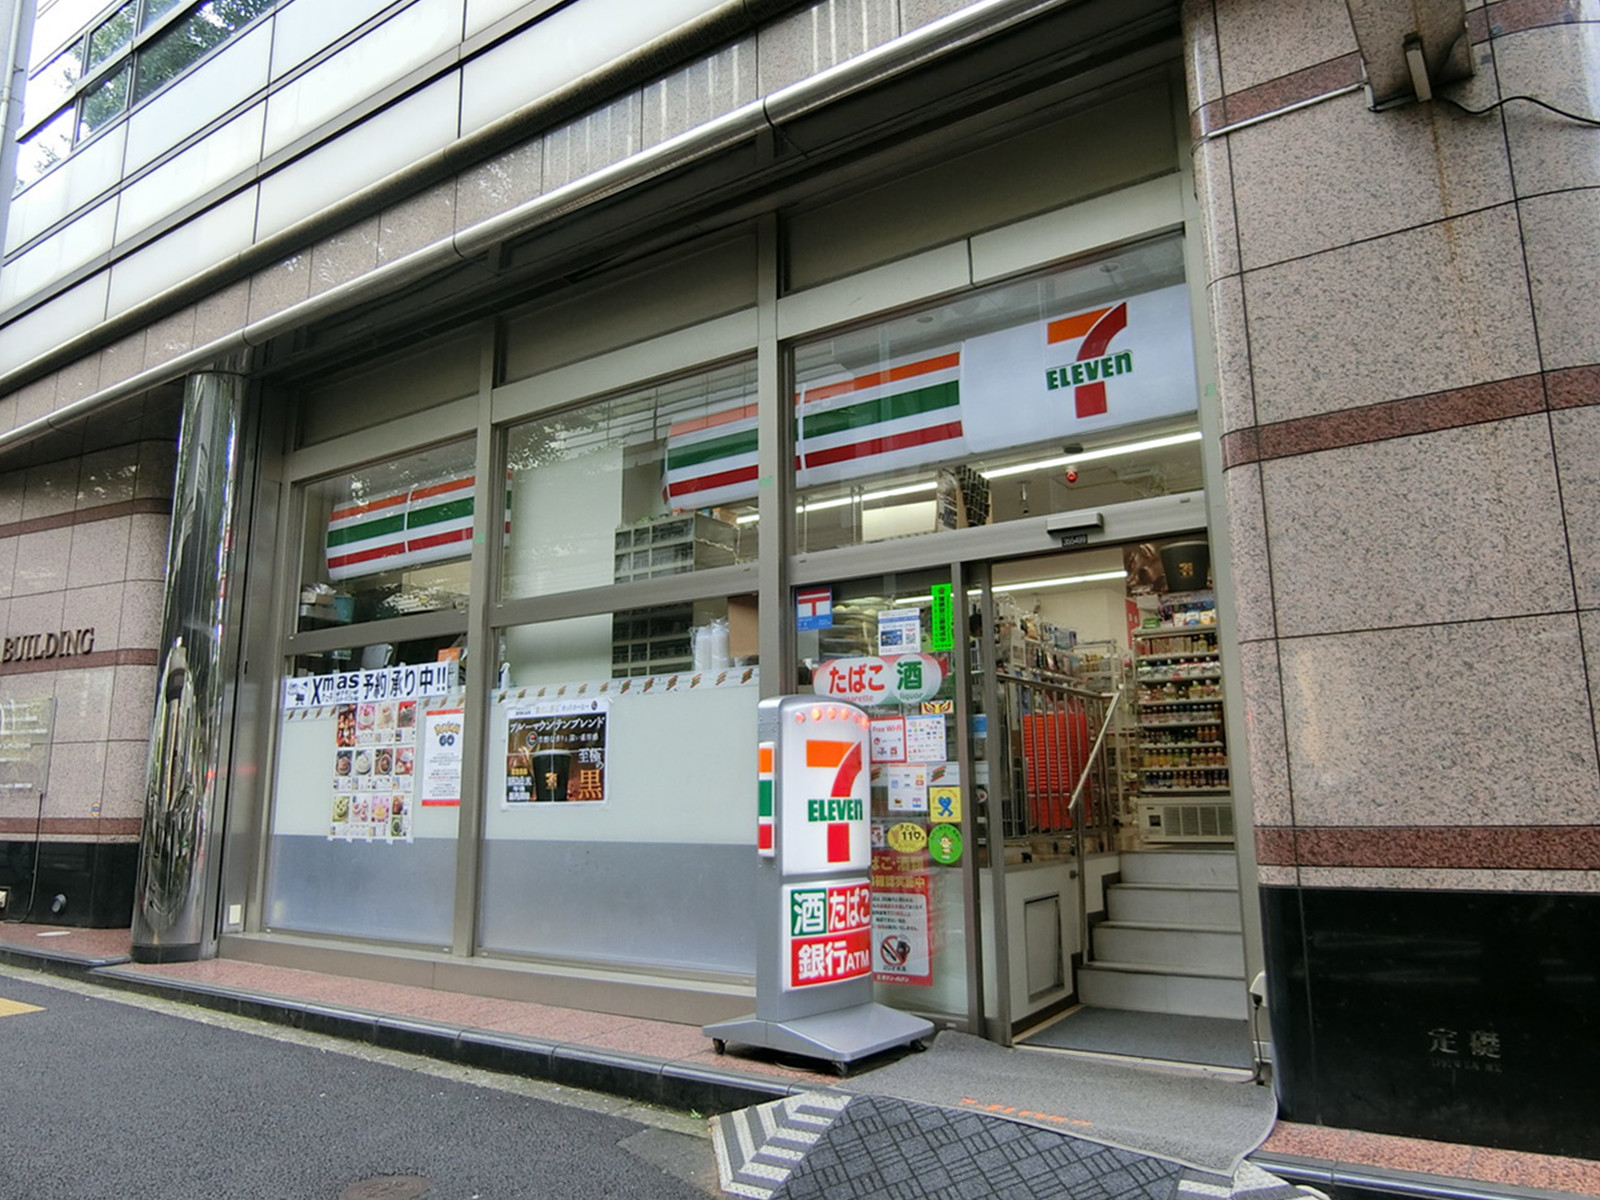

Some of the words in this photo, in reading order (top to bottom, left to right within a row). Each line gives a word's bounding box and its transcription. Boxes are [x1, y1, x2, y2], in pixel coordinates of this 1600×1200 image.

[3, 627, 95, 663] BUILDING
[828, 663, 885, 694] たばこ
[897, 661, 922, 690] 酒
[578, 769, 602, 799] 黒
[794, 892, 825, 934] 酒
[829, 887, 870, 930] たばこ
